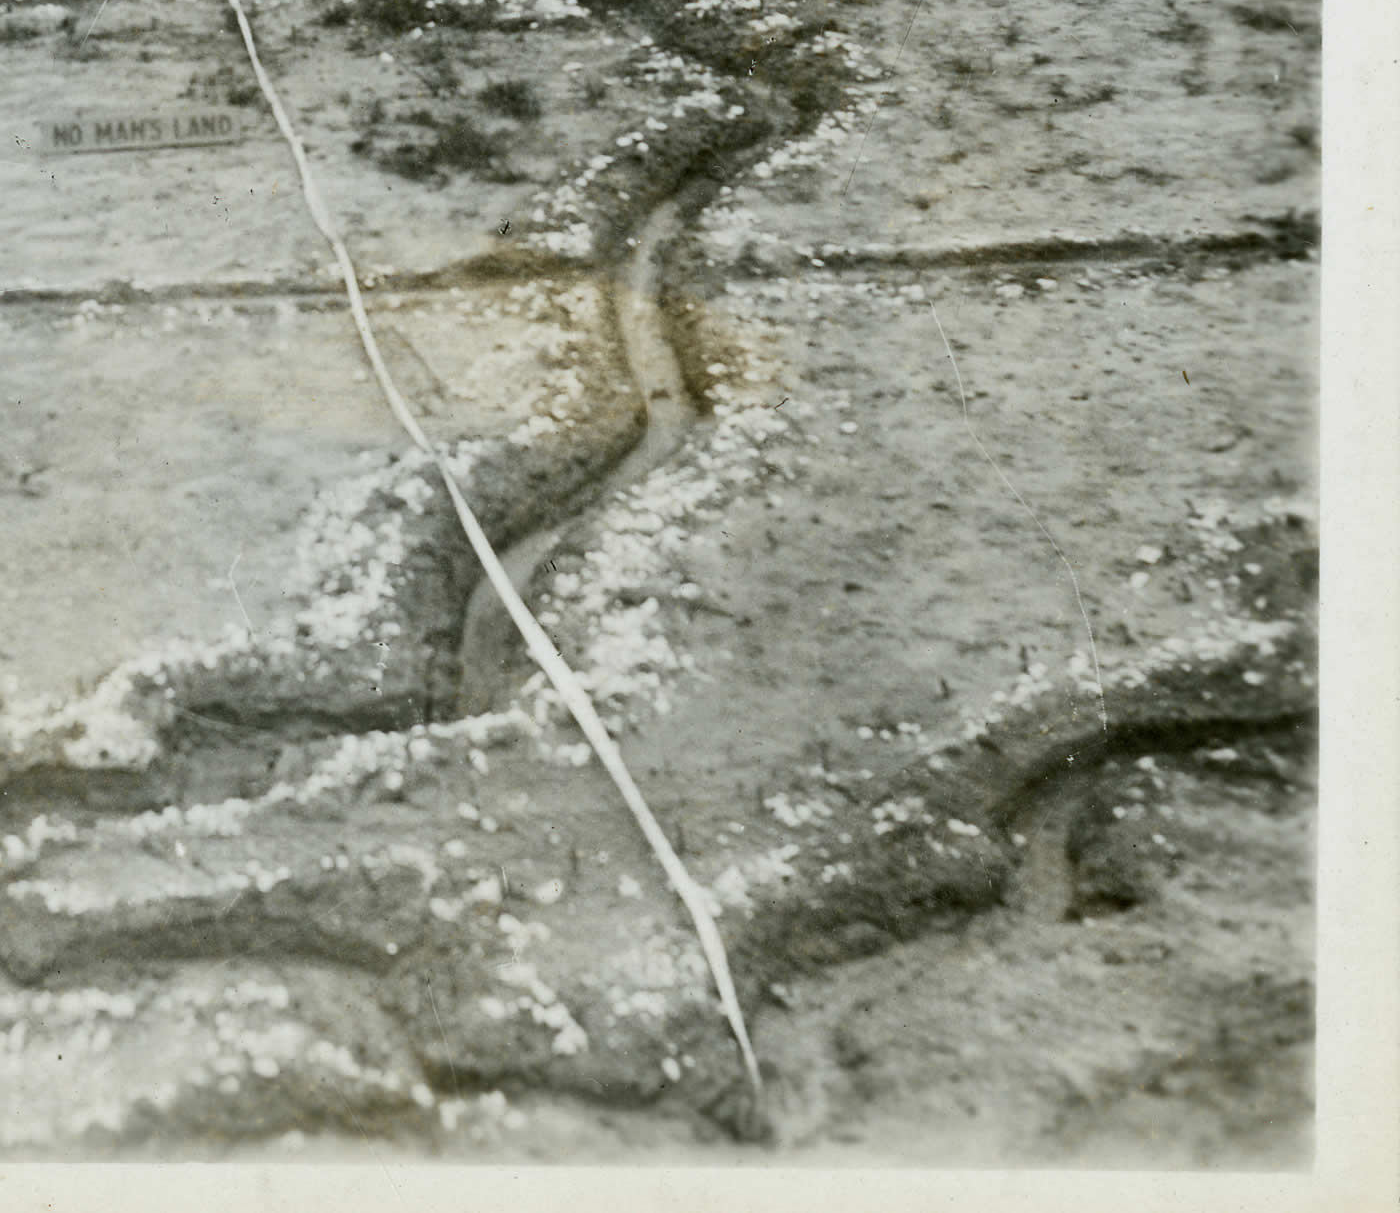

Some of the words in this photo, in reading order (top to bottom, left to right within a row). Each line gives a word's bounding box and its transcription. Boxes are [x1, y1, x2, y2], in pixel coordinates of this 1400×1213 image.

[52, 122, 84, 148] NO
[94, 118, 163, 143] MAN'S
[173, 113, 233, 139] LAND
